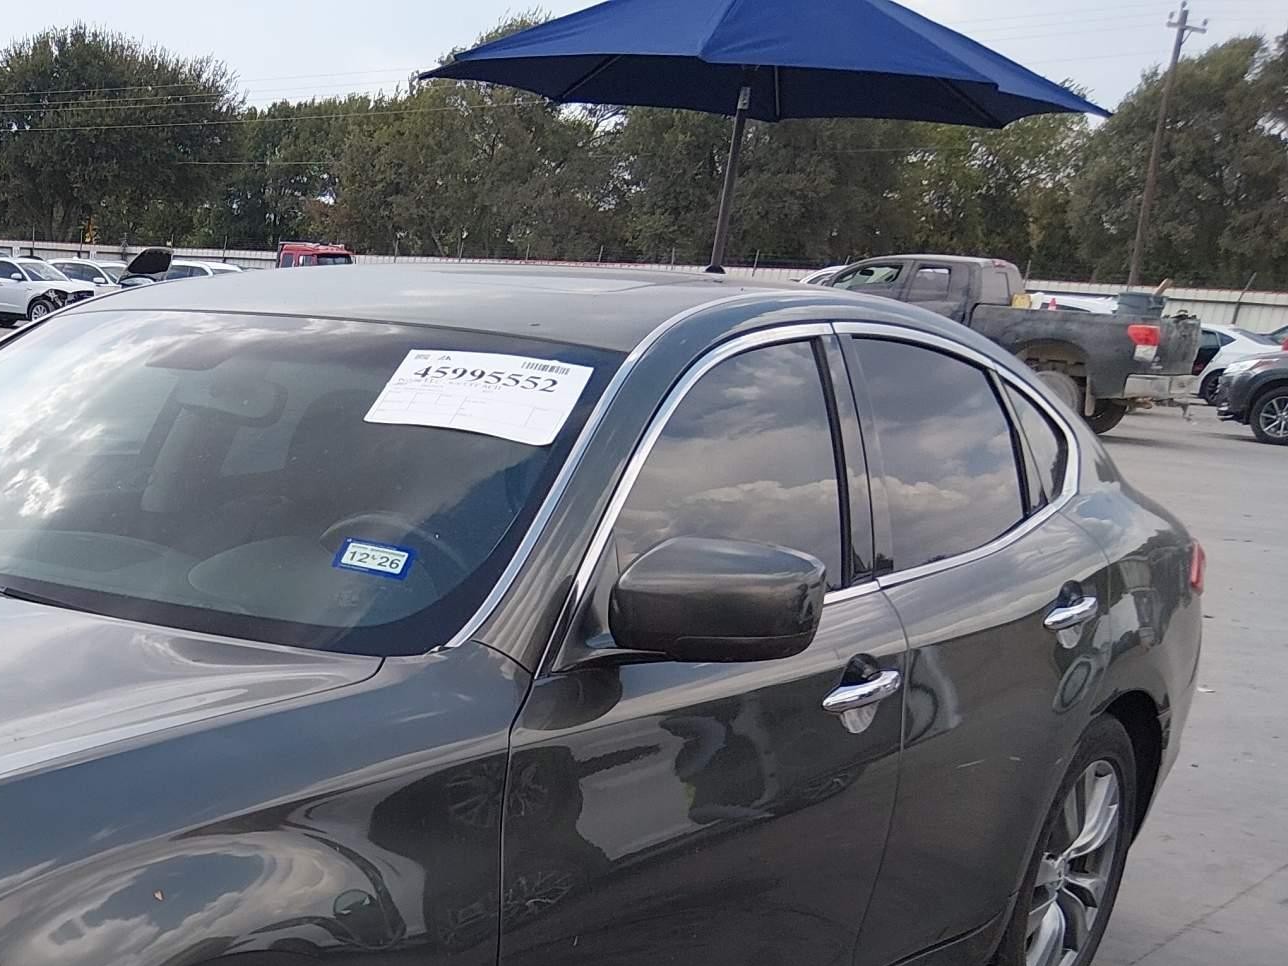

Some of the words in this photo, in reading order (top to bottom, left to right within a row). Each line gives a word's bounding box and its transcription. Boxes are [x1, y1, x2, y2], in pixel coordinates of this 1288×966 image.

[413, 365, 559, 393] 45995552
[349, 550, 370, 564] 12
[377, 555, 401, 570] 26
